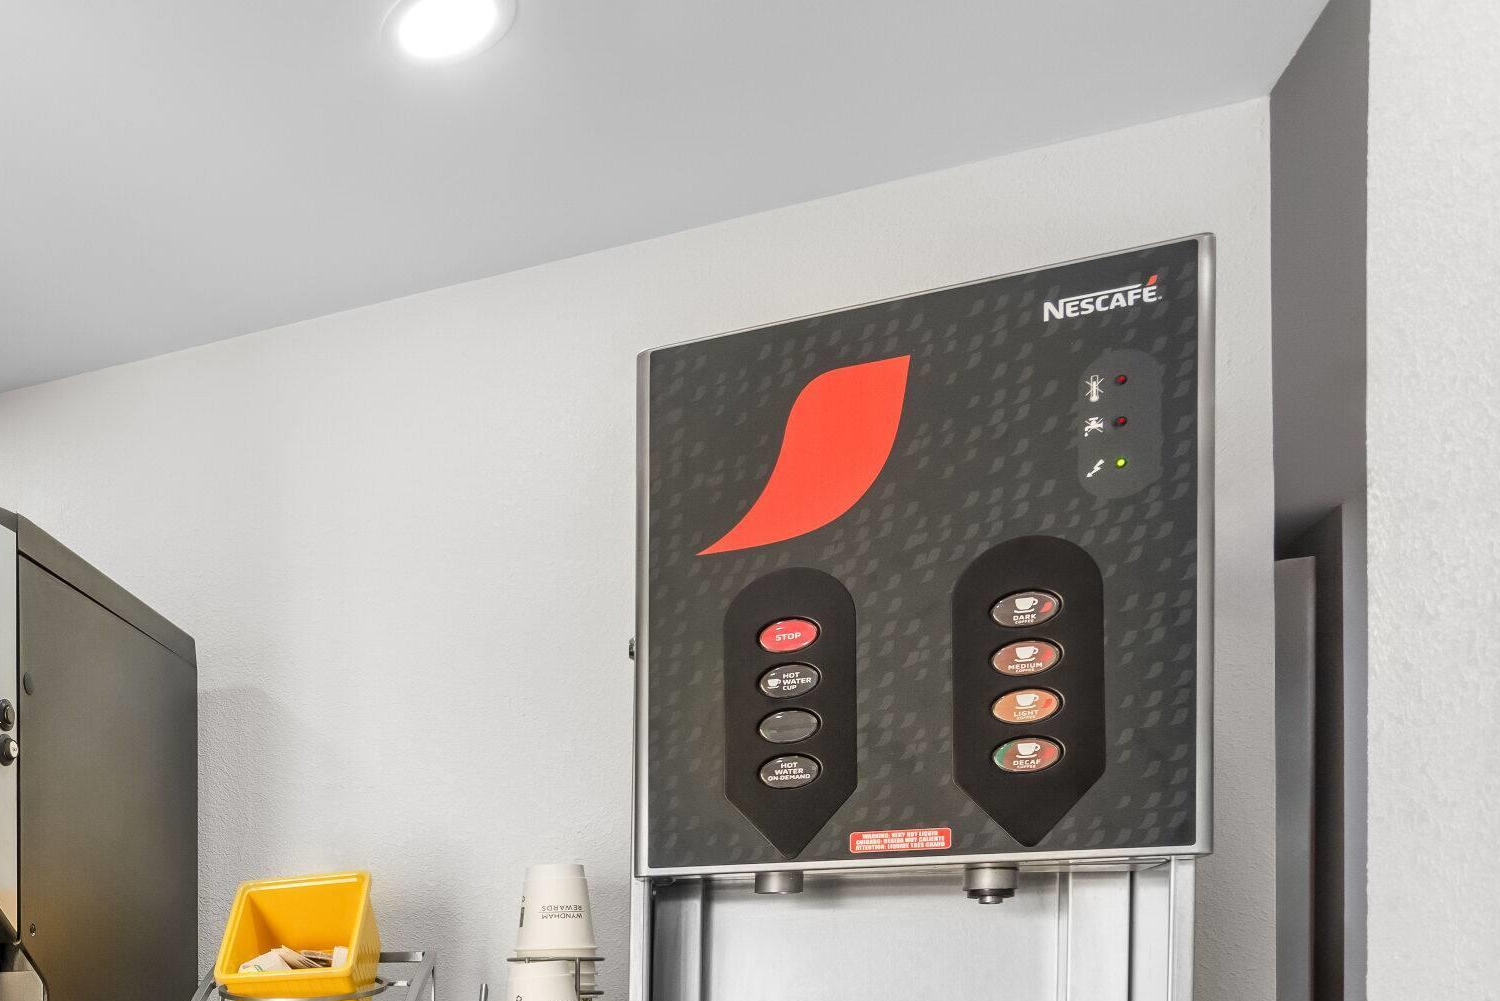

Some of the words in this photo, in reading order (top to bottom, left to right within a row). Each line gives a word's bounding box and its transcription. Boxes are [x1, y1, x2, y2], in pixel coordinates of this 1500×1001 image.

[1043, 275, 1157, 322] NESCAFÉ
[1012, 614, 1036, 622] DARK
[775, 632, 802, 641] STOP
[1008, 662, 1043, 670] MEDIUM
[542, 904, 582, 912] REWARDS
